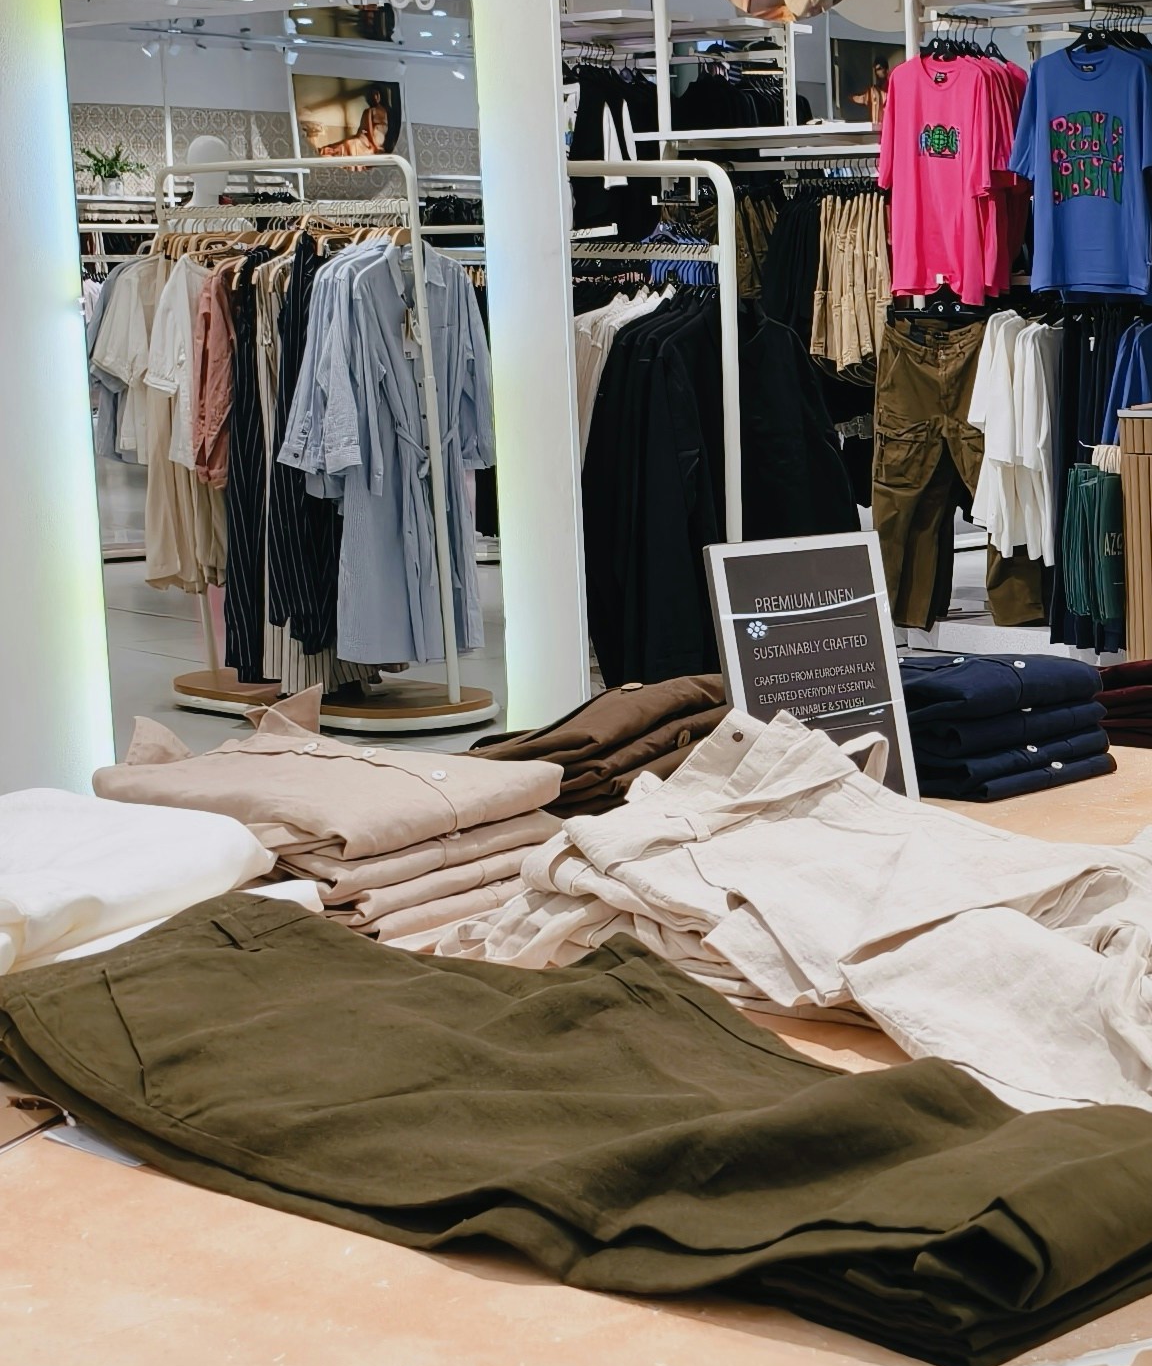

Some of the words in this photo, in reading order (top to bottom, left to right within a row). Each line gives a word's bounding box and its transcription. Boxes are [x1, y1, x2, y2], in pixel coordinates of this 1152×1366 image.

[754, 592, 816, 613] PREMIUM
[818, 587, 854, 606] LINEN
[753, 640, 821, 661] SUSTAINABLY
[822, 634, 868, 651] CRAFTED
[754, 673, 790, 687] CRAFTED
[791, 669, 814, 682] FROM
[815, 664, 856, 679] EUROPEAN
[857, 661, 876, 672] FLAX
[758, 690, 798, 705] ELEVATED
[798, 685, 837, 699] EVERYDAY
[837, 679, 876, 693] ESSENTIAL
[776, 702, 827, 717] STAINABLE
[828, 701, 835, 710] &
[835, 697, 865, 709] STYLISH
